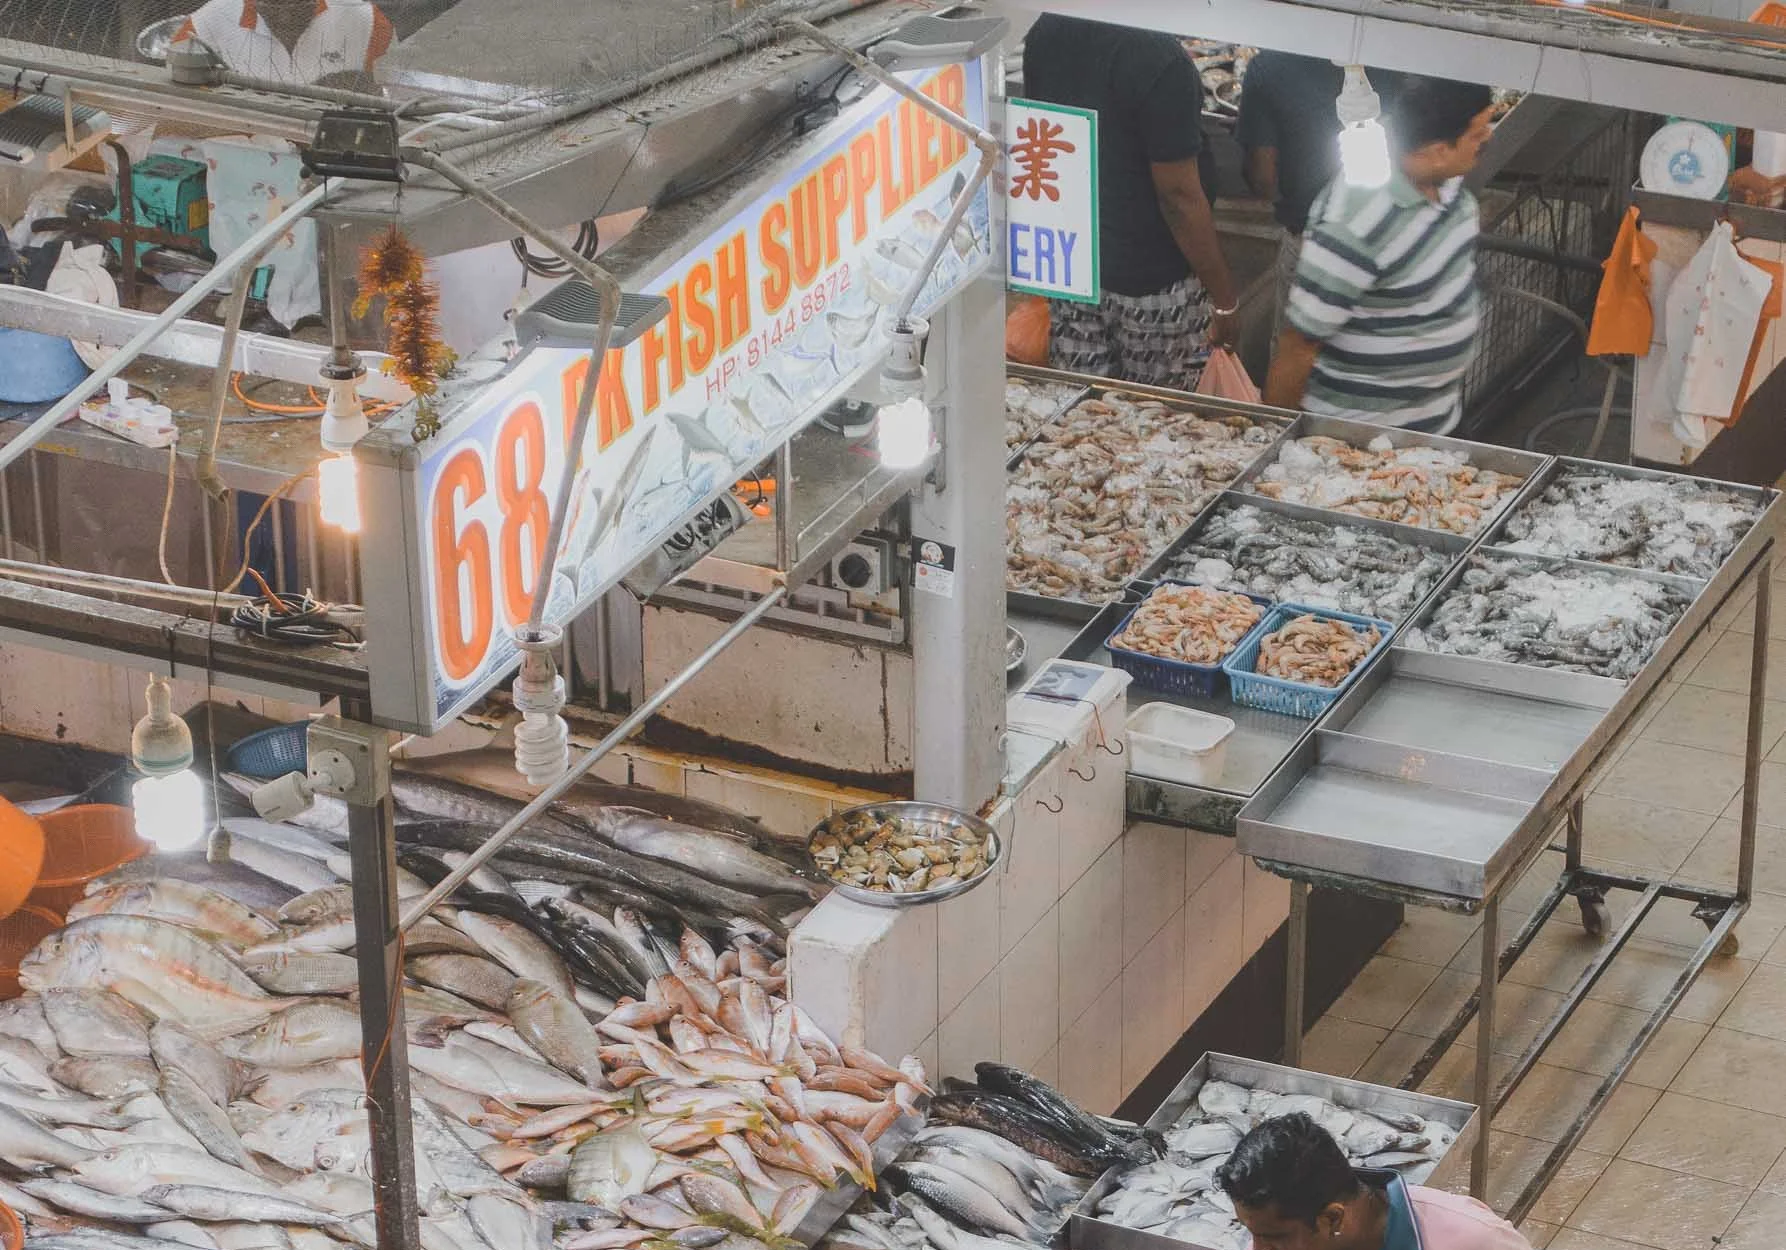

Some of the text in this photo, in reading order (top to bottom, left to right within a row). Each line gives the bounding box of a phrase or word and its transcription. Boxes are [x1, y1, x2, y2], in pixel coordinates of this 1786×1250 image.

[1009, 117, 1076, 202] 業
[1009, 222, 1078, 287] ERY
[430, 399, 552, 681] 68
[641, 230, 750, 415] FISH
[759, 63, 968, 315] SUPPLIER
[705, 262, 851, 401] HP: 8144 8872
